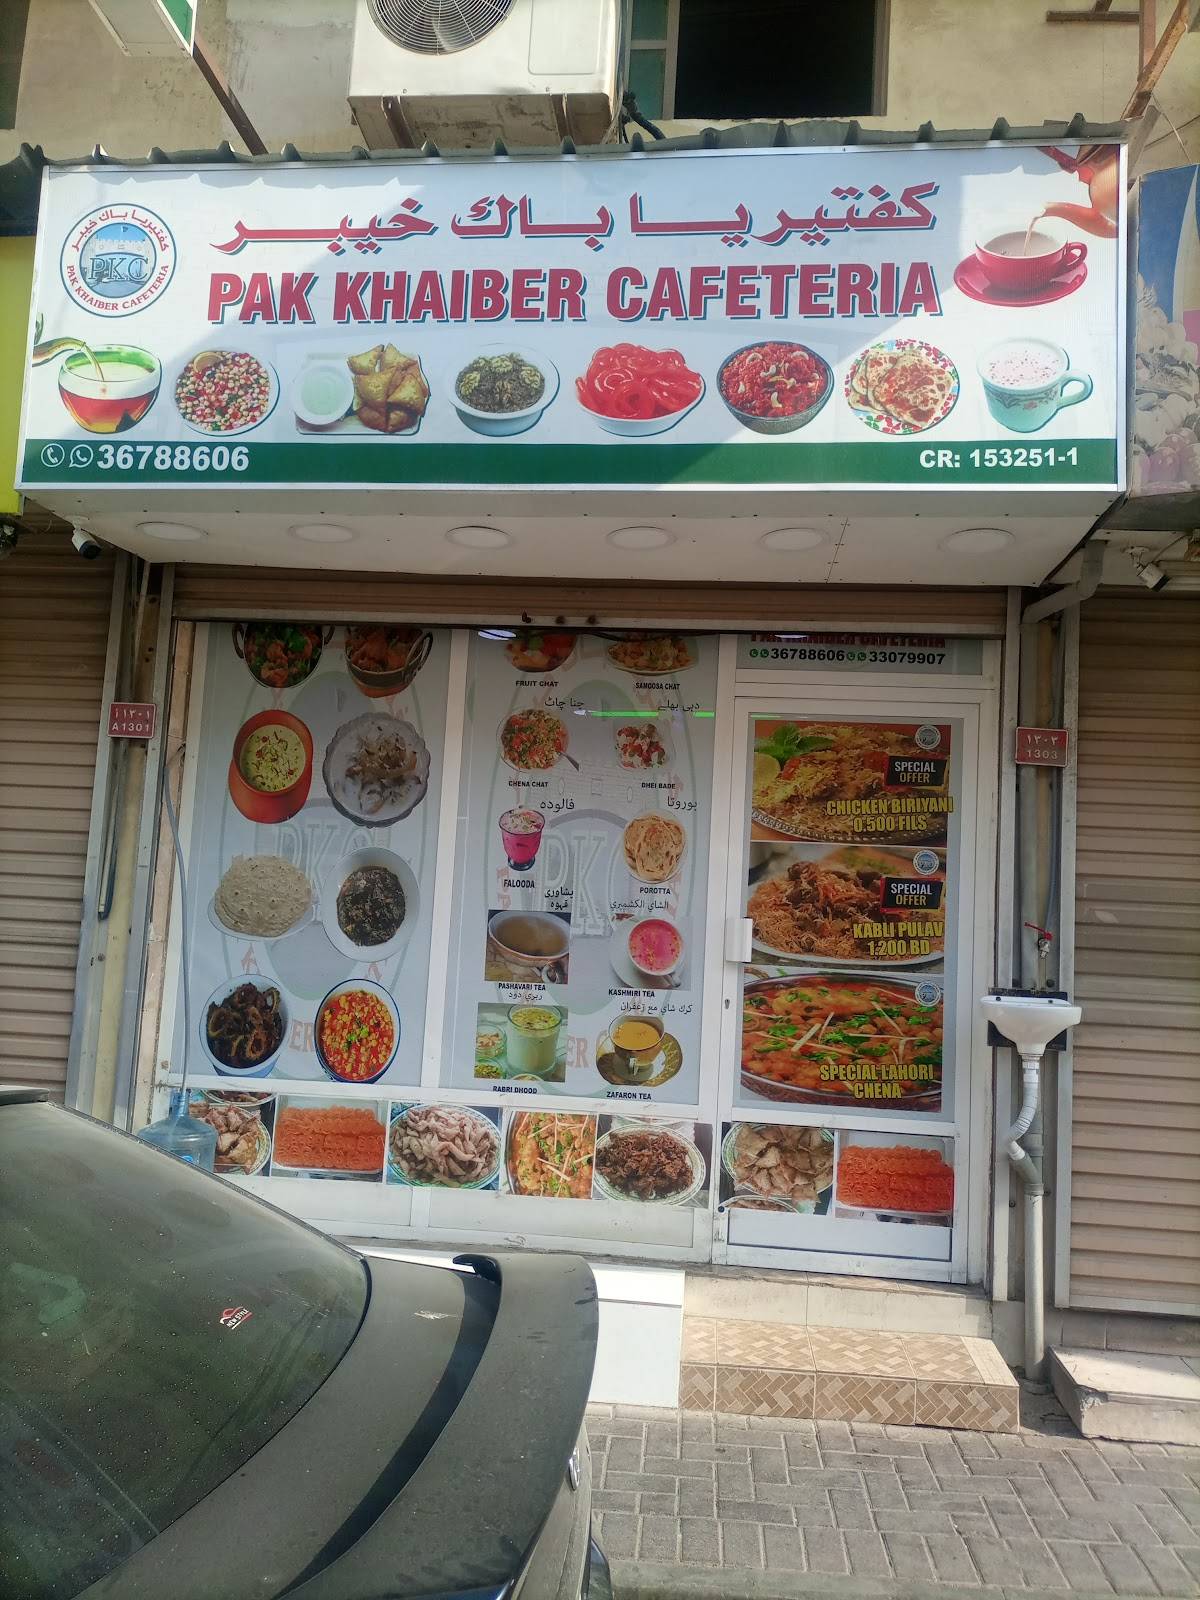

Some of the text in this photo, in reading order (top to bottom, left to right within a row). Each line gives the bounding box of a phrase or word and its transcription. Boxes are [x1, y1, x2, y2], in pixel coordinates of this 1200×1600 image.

[208, 181, 939, 256] كفتيريا باك خيبر
[87, 256, 149, 280] PKC
[66, 265, 169, 311] PAK KHAIBER CAFETERIA
[206, 261, 944, 324] PAK KHAIBER CAFETERIA
[97, 444, 250, 473] 36788606
[919, 447, 1079, 468] CR: 153251-1
[771, 647, 946, 665] 36788606 33079907
[515, 680, 559, 688] FRUIT CHAT
[111, 722, 150, 732] A1301
[1027, 749, 1058, 760] 1303
[894, 760, 937, 773] SPECIAL
[508, 780, 549, 788] CHENA CHAT
[899, 771, 930, 784] OFFER
[826, 796, 954, 816] CHICKEN BIRIYANI
[897, 814, 928, 832] FILS
[503, 879, 535, 889] FALOODA
[891, 883, 932, 895] SPECIAL
[639, 887, 671, 895] POROTTA
[895, 894, 927, 906] OFFER
[853, 921, 943, 939] KABLI PULAV
[909, 939, 931, 957] BD
[498, 982, 546, 992] PASHAVARI TEA
[608, 988, 655, 998] KASHMIRI TEA
[819, 1063, 934, 1081] SPECIAL LAHORI
[492, 1085, 538, 1095] RABRI DHOOD
[606, 1091, 652, 1100] ZAFARON TEA
[853, 1082, 901, 1099] CHENA
